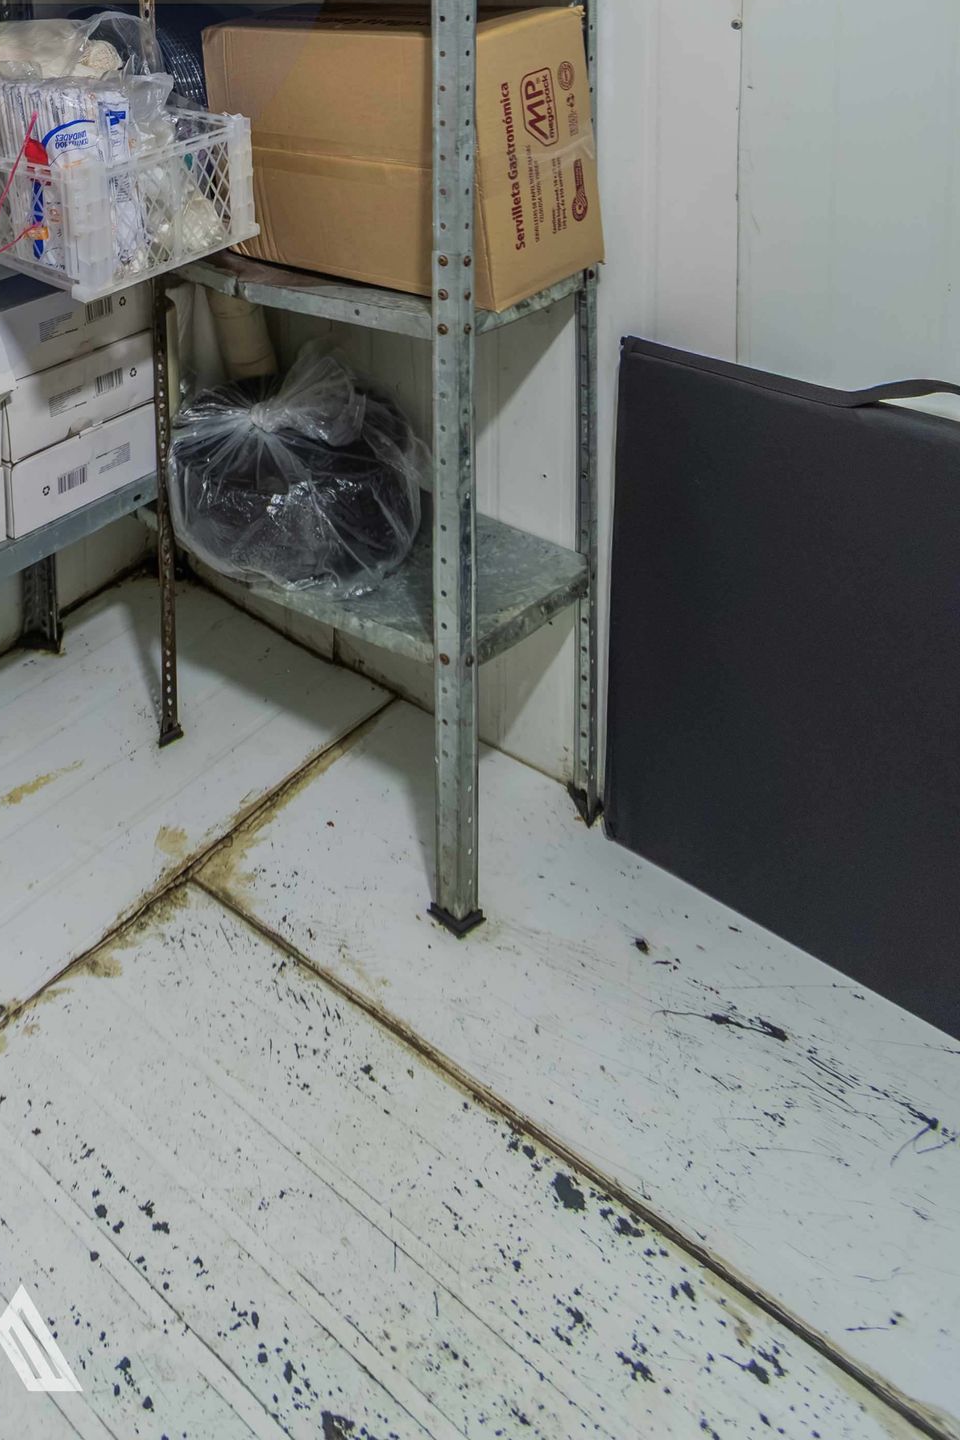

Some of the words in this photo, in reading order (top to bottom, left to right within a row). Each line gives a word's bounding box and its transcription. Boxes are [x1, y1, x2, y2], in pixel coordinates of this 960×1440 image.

[500, 82, 518, 180] Gastronómica
[524, 80, 548, 140] MP
[542, 74, 554, 138] mega-pack
[55, 141, 68, 149] 100
[511, 182, 526, 250] Servilleta
